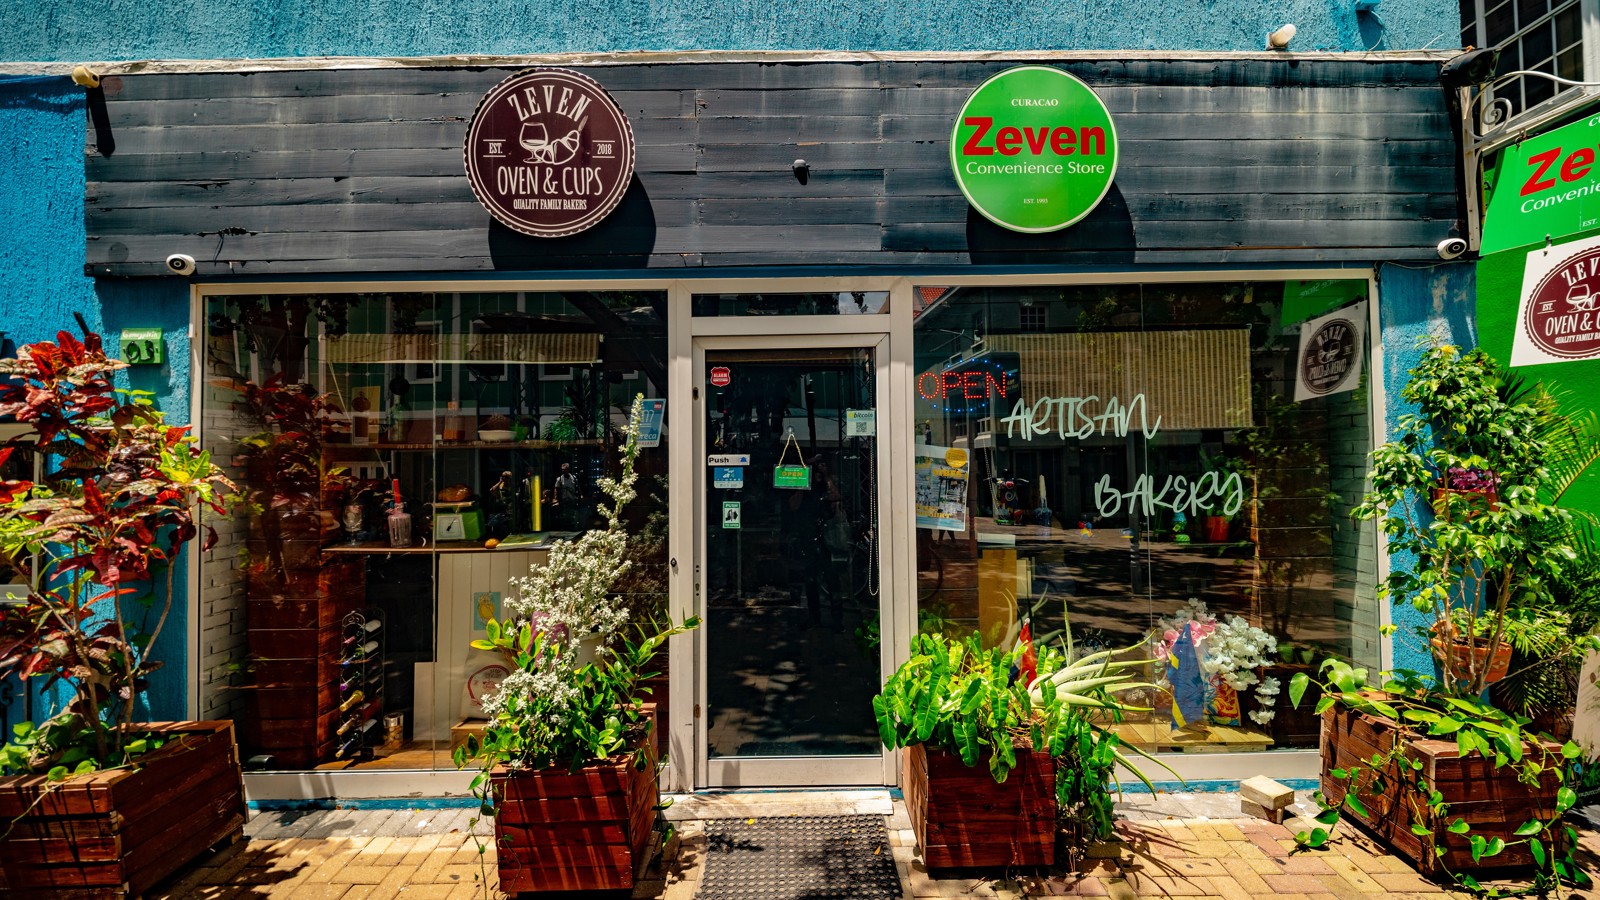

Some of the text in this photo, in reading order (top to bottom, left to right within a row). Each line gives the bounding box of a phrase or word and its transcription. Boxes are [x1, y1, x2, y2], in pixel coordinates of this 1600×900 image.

[507, 85, 592, 122] ZEVEN
[1011, 98, 1059, 106] CURACAO
[489, 143, 502, 154] EST.
[962, 116, 1106, 156] Zeven
[596, 144, 612, 154] 2018
[966, 161, 1105, 174] Convenience Store
[497, 166, 603, 196] OVEN & CUPS
[513, 198, 587, 210] QUALITY FAMILY BAKERS
[1561, 257, 1600, 286] ZEV
[1542, 303, 1553, 311] EST.
[1546, 314, 1578, 336] OVEN
[1580, 312, 1593, 331] &
[918, 372, 1006, 399] OPEN
[1000, 393, 1161, 442] ARTISAN
[1094, 470, 1242, 518] BAKERY
